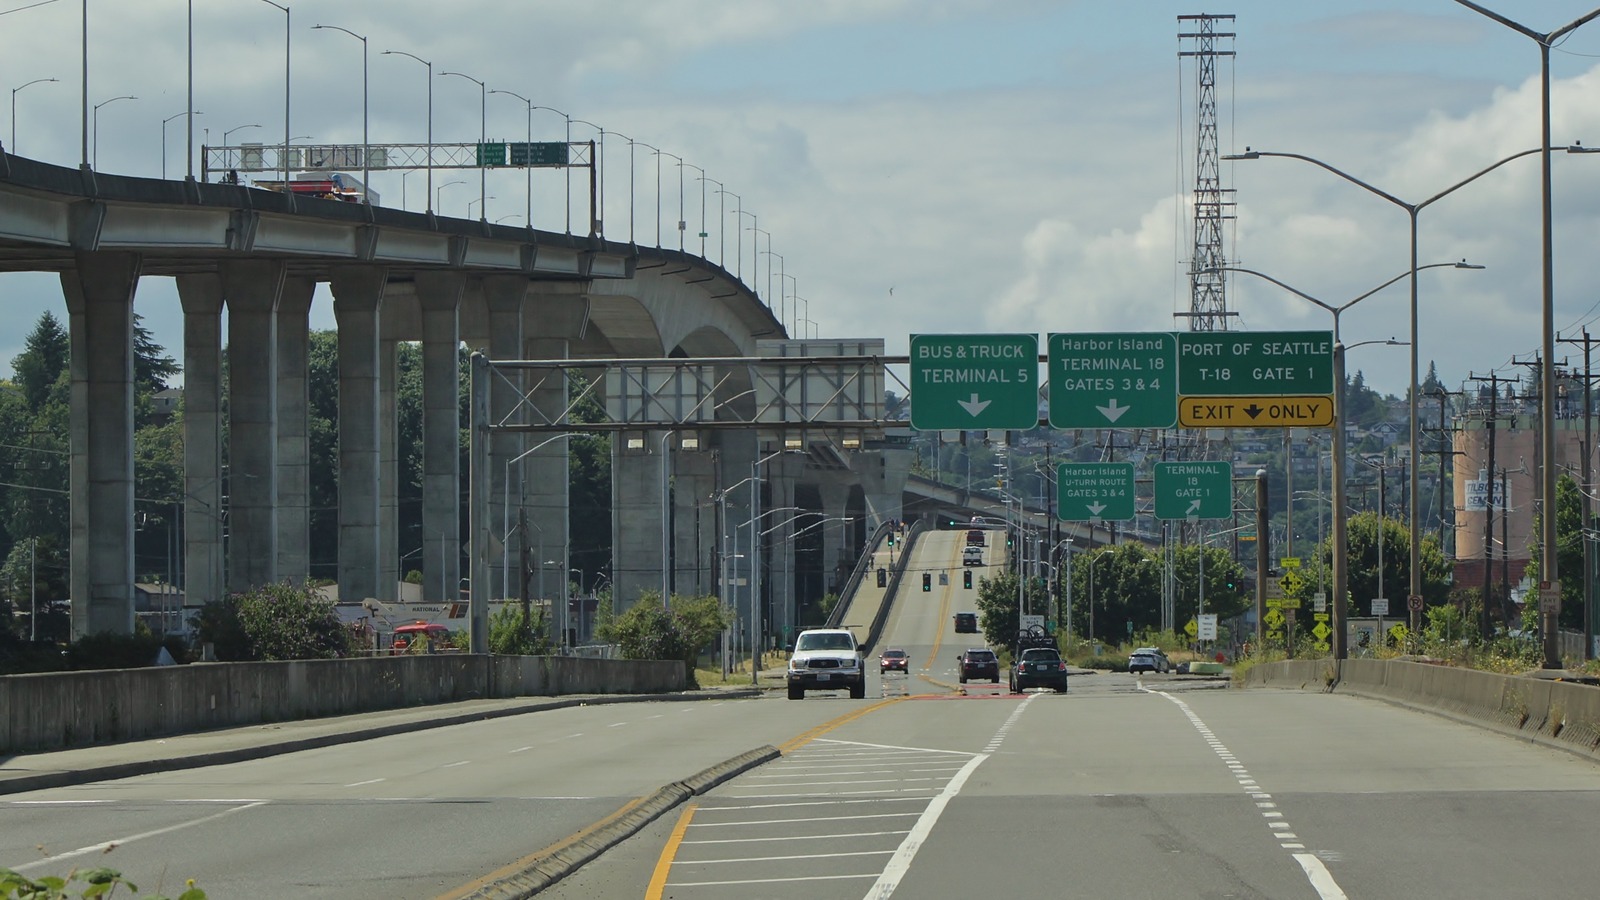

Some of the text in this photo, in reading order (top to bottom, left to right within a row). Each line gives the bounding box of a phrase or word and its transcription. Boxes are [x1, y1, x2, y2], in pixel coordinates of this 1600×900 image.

[1063, 339, 1162, 350] Harbor Island
[1183, 342, 1329, 355] PORT OF SEATTLE
[920, 345, 1023, 358] BUS & TRUCK
[1062, 358, 1164, 370] TERMINAL 18
[922, 369, 1027, 382] TERMINAL 5
[1200, 368, 1313, 380] T-18 GATE 1
[1065, 378, 1160, 390] GATES 3 & 4
[1193, 405, 1319, 419] EXIT ONLY
[1166, 466, 1219, 474] TERMINAL
[1188, 477, 1197, 485] 18
[1068, 489, 1097, 497] GATES
[1176, 489, 1201, 497] GATE
